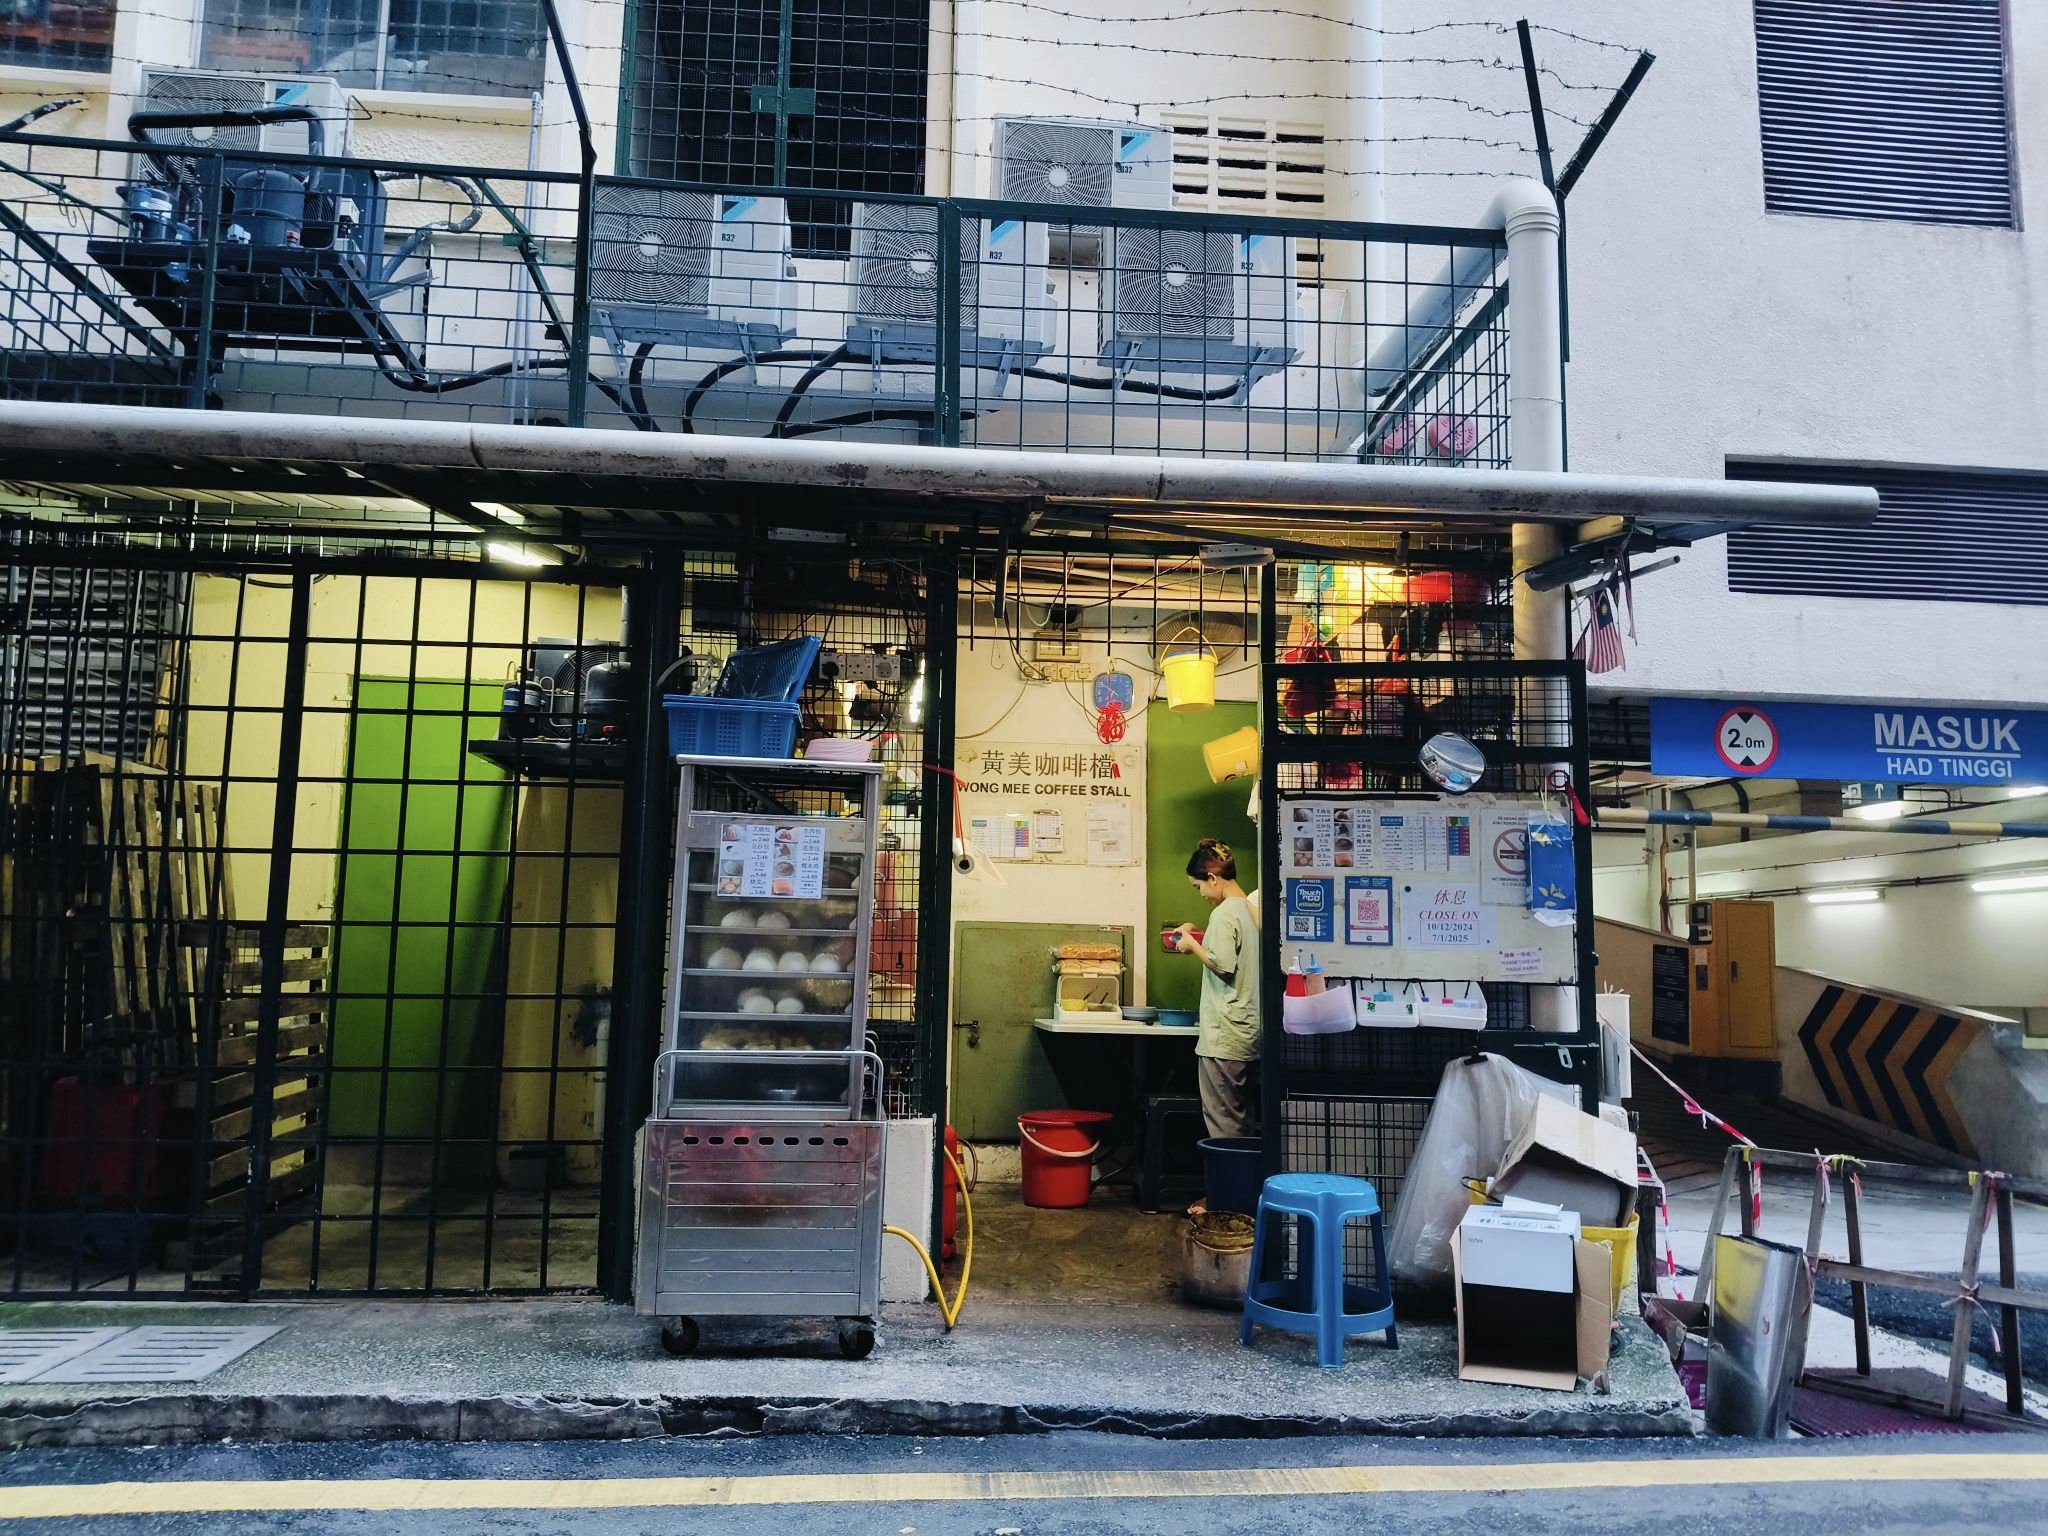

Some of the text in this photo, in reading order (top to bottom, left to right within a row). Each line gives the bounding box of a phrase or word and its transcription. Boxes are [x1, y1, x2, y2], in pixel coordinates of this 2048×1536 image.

[721, 233, 735, 242] R32
[990, 251, 1003, 260] R32
[1874, 712, 2021, 752] MASUK
[1727, 727, 1766, 750] 2.0m
[1887, 757, 2013, 778] HAD TINGGI
[958, 782, 1132, 799] WONG MEE COFFEE STALL
[1298, 889, 1321, 897] Touch
[1434, 889, 1467, 905] 休息
[1419, 911, 1480, 921] CLOSE ON
[1427, 923, 1473, 932] 10/12/2024
[1432, 934, 1469, 943] 7/1/2025
